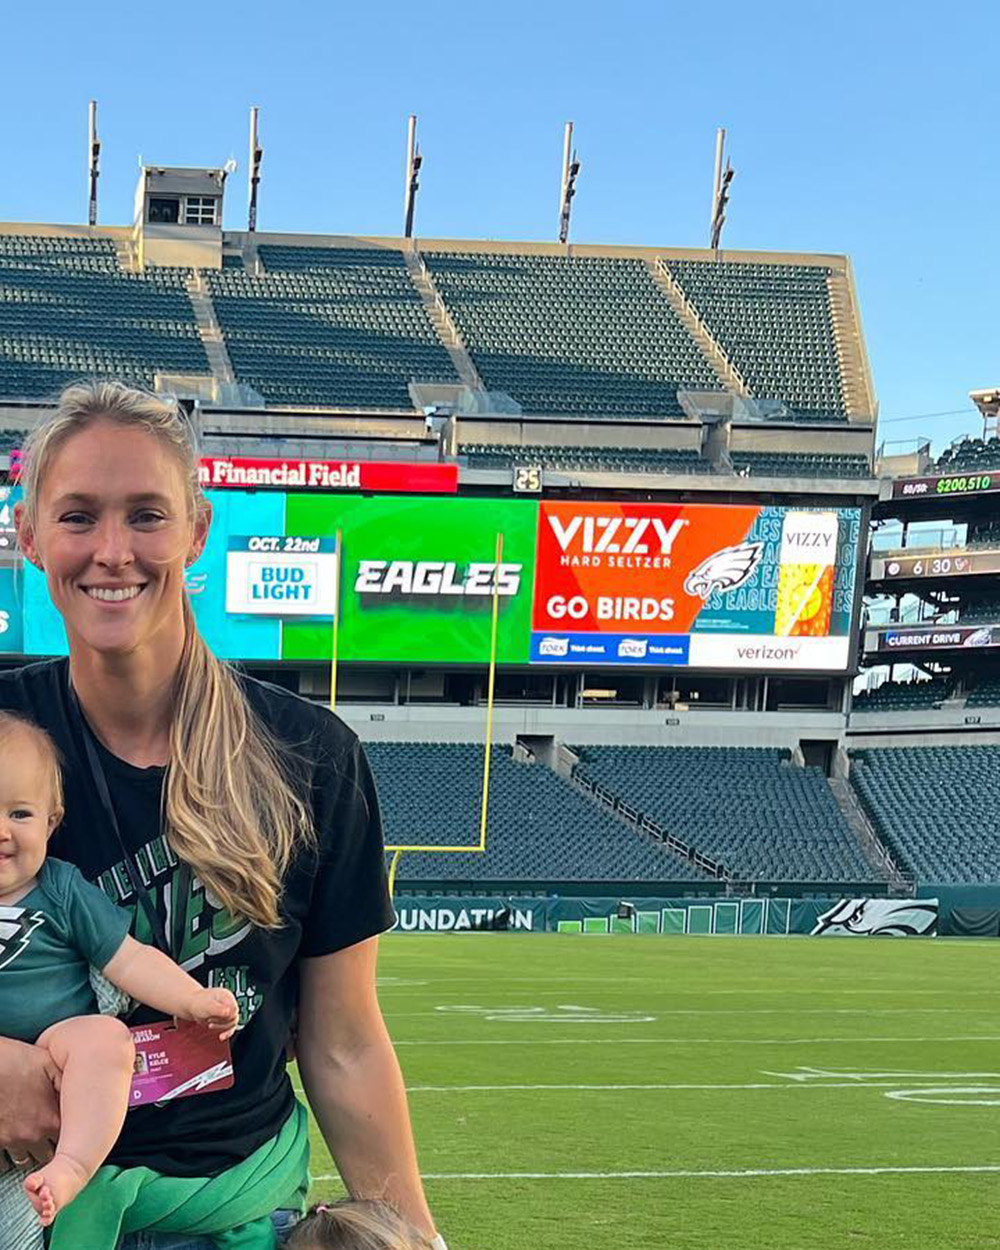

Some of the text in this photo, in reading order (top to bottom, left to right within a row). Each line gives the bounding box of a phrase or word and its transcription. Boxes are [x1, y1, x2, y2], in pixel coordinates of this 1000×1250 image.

[213, 461, 306, 485] Financial
[309, 464, 361, 487] Field
[517, 470, 539, 490] 25
[937, 476, 990, 493] $200,510
[548, 516, 685, 554] VIZZY
[786, 532, 833, 547] VIZZY
[248, 537, 320, 552] OCT. 22nd
[560, 554, 672, 569] HARD SELTZER
[913, 560, 951, 575] 6 30
[261, 567, 305, 583] BUD
[354, 560, 523, 596] EAGLES
[252, 584, 312, 600] LIGHT
[546, 595, 589, 620] GO
[596, 597, 675, 621] BIRDS
[888, 633, 960, 646] CURRENT DRIVE
[737, 645, 794, 660] verizon
